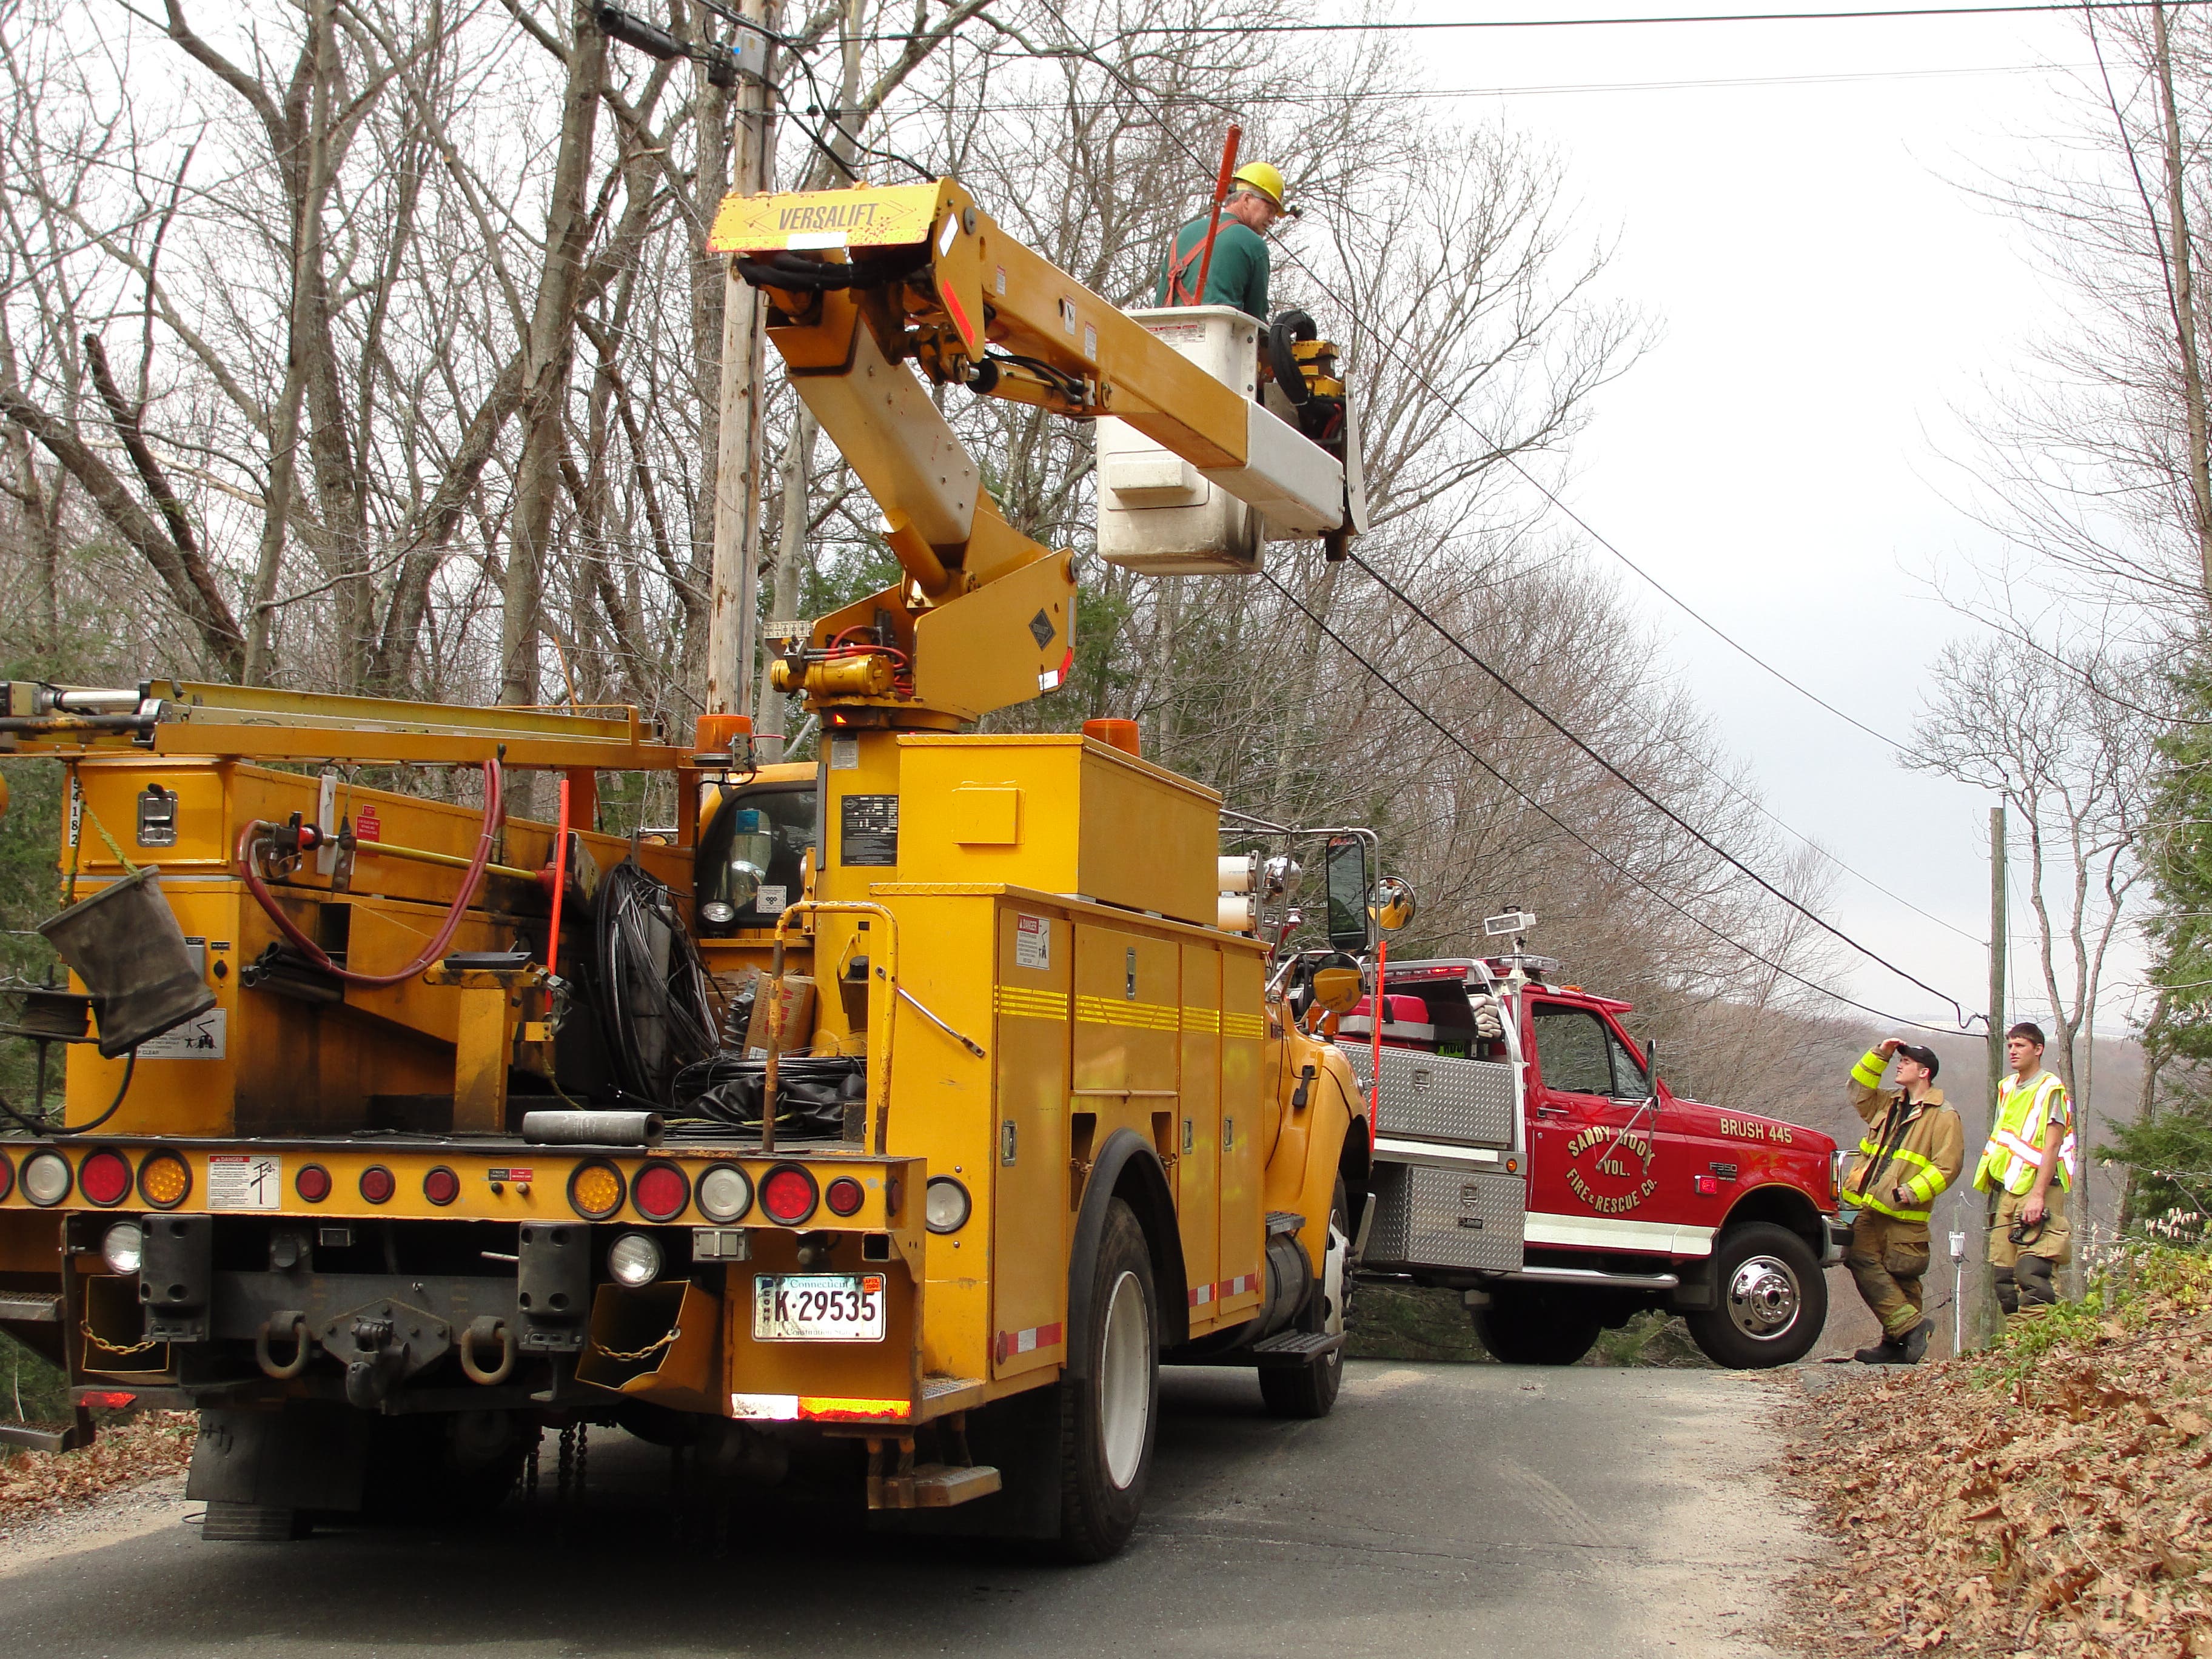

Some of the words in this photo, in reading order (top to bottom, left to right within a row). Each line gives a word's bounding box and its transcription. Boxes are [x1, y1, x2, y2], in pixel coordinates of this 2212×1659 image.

[778, 203, 880, 230] VERSALIFT
[1567, 1126, 1610, 1157] SANDY
[1720, 1118, 1765, 1140] BRUSH
[1769, 1125, 1792, 1144] 445
[1603, 1159, 1631, 1176] VOL.
[1566, 1167, 1590, 1202] FIRE
[1587, 1194, 1595, 1204] &
[1594, 1190, 1641, 1213] RESCUE
[1641, 1179, 1658, 1197] CO.
[790, 1279, 848, 1289] Connecticut
